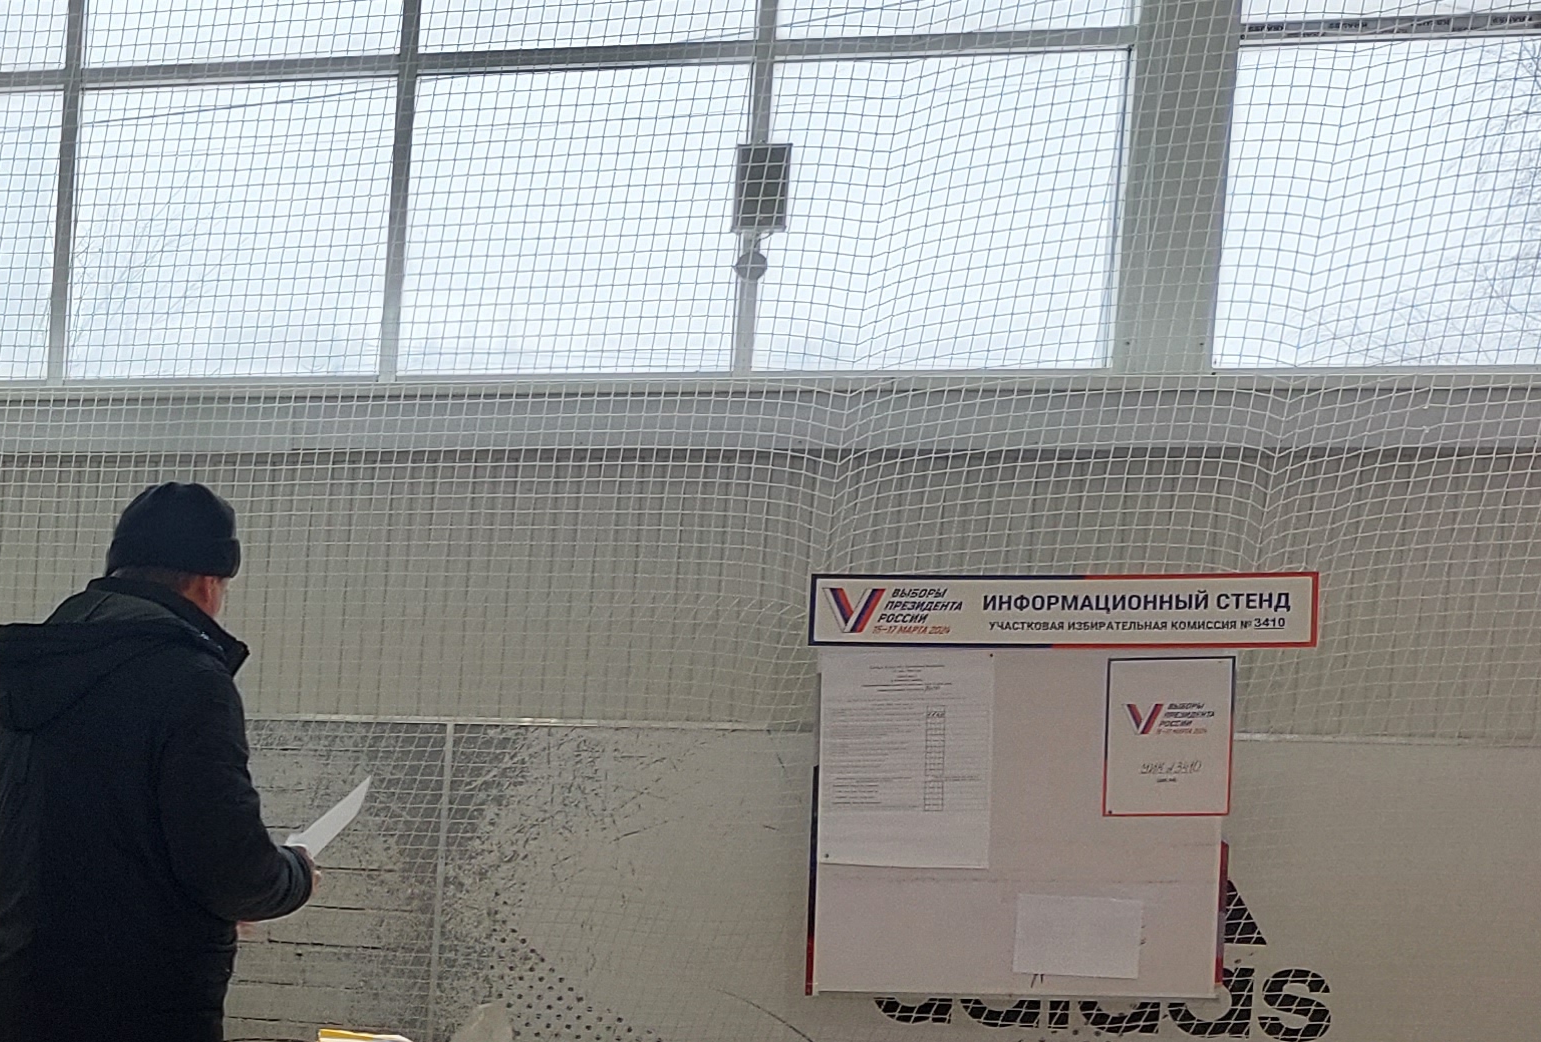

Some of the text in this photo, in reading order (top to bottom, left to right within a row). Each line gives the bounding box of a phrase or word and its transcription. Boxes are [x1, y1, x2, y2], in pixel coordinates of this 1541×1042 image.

[891, 587, 948, 599] ВЫБОРЫ
[883, 600, 963, 612] ПРЕЗИДЕНТА
[982, 589, 1292, 615] ИНФОРМАЦИОННЫЙ СТЕНД
[877, 612, 929, 624] РОССИИ
[988, 621, 1065, 632] УЧАСТКОВАЯ
[1067, 620, 1168, 631] ИЗБИРАТЕЛЬНАЯ
[1170, 619, 1237, 631] КОМИССИЯ
[1253, 617, 1286, 628] 3410
